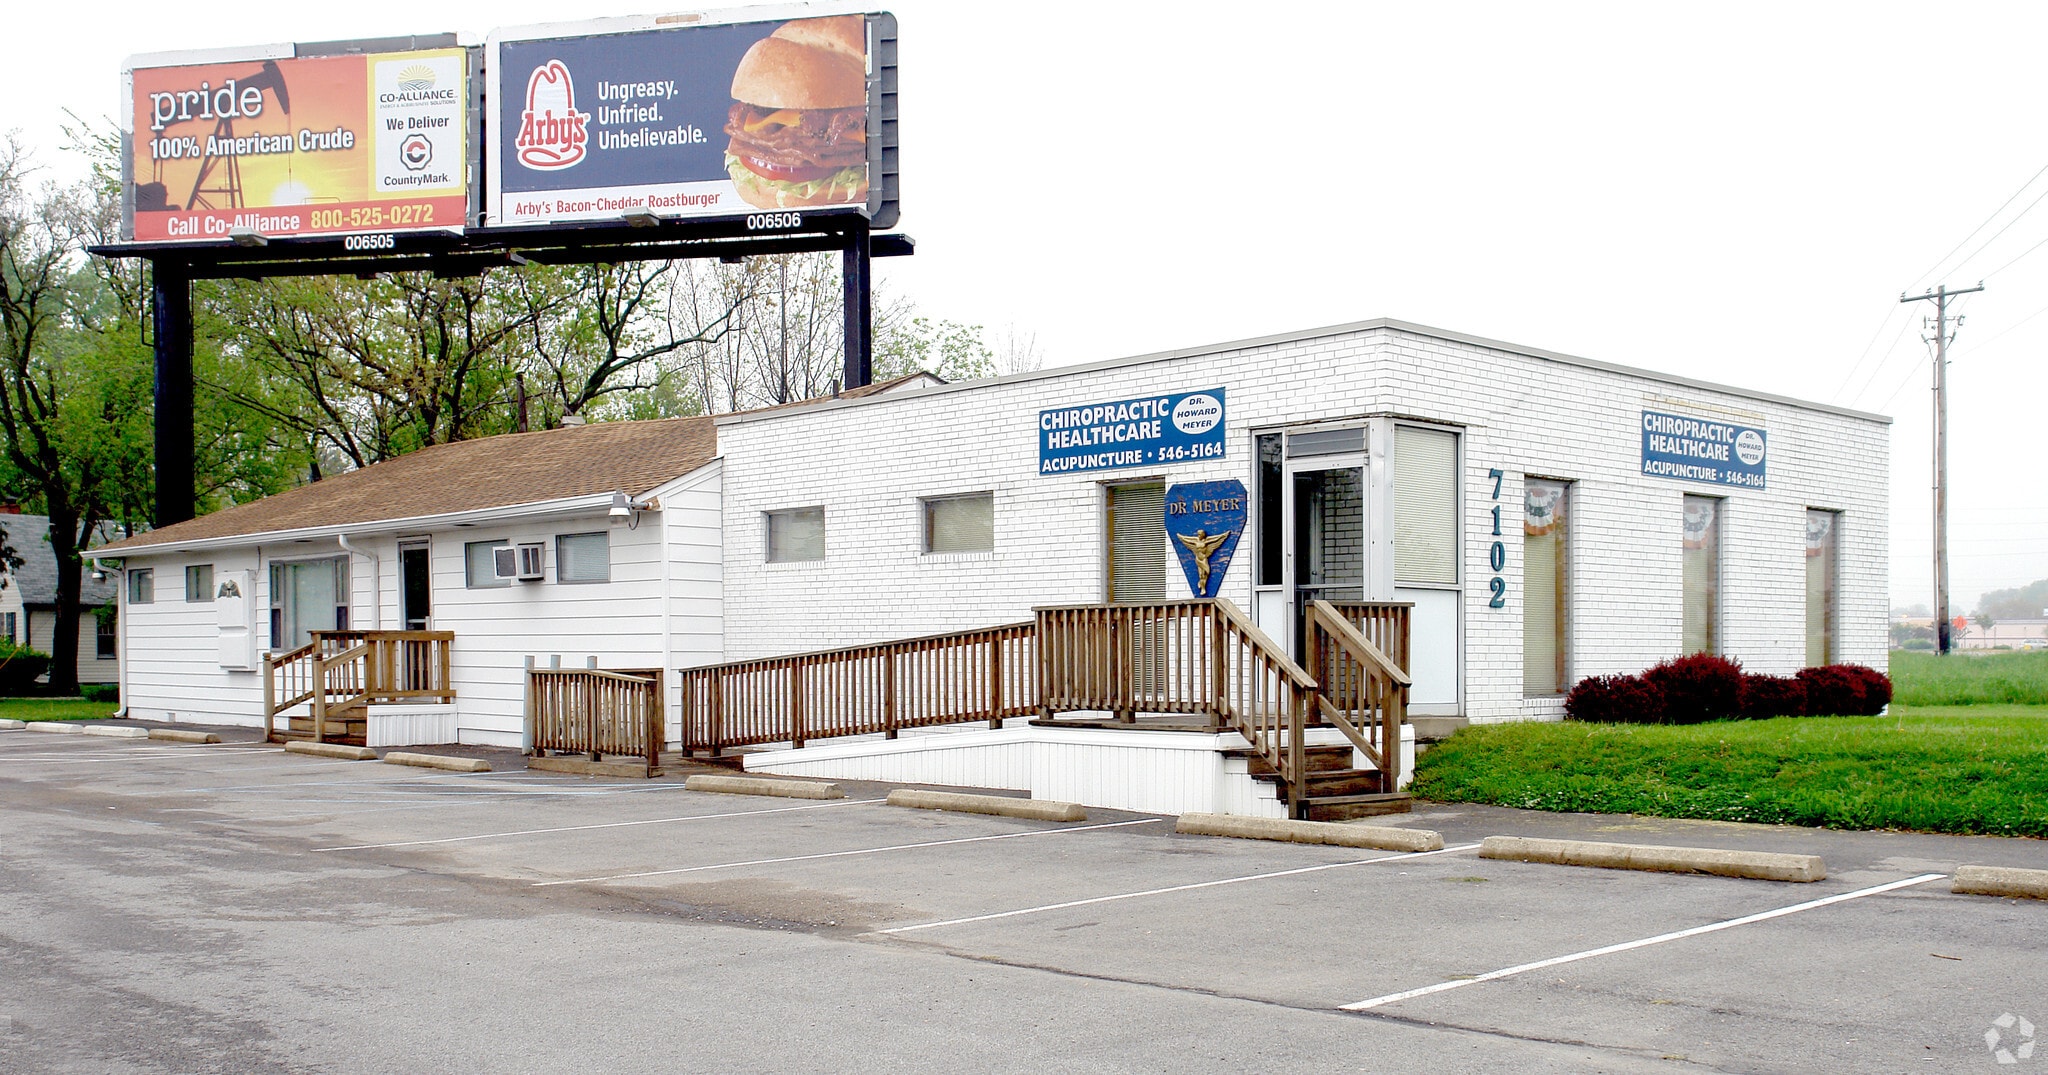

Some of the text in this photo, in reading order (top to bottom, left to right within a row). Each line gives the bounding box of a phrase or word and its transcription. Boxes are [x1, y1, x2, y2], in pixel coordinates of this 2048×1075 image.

[598, 80, 679, 103] Ungreasy.
[150, 80, 263, 131] pride
[598, 102, 664, 125] Unfried.
[386, 115, 450, 130] We Deliver
[518, 110, 586, 153] Arby's
[150, 127, 354, 159] 100% American Crude
[598, 124, 708, 150] Unbelievable.
[384, 173, 449, 186] CountryMark
[310, 203, 434, 229] 800-525-0272
[515, 192, 721, 217] Arby's Bacon-Cheddar Roastburger
[167, 213, 300, 236] Call Co-Alliance
[747, 214, 802, 230] 006506
[345, 234, 395, 250] 006505
[1177, 406, 1218, 419] HOWARD
[1189, 397, 1206, 406] DR.
[1040, 398, 1170, 431] CHIROPRACTIC
[1182, 419, 1213, 430] MEYER
[1048, 420, 1162, 450] HEALTHCARE
[1643, 413, 1735, 444] CHIROPRACTIC
[1041, 441, 1223, 473] ACUPUNCTURE 546-5164
[1649, 433, 1729, 461] HEALTHCARE
[1737, 442, 1763, 451] HOWARD
[1741, 452, 1760, 461] MEYER
[1644, 459, 1764, 487] ACUPUNCTURE 546-5164
[1169, 497, 1241, 516] DR MEYER
[1488, 468, 1506, 609] 7102
